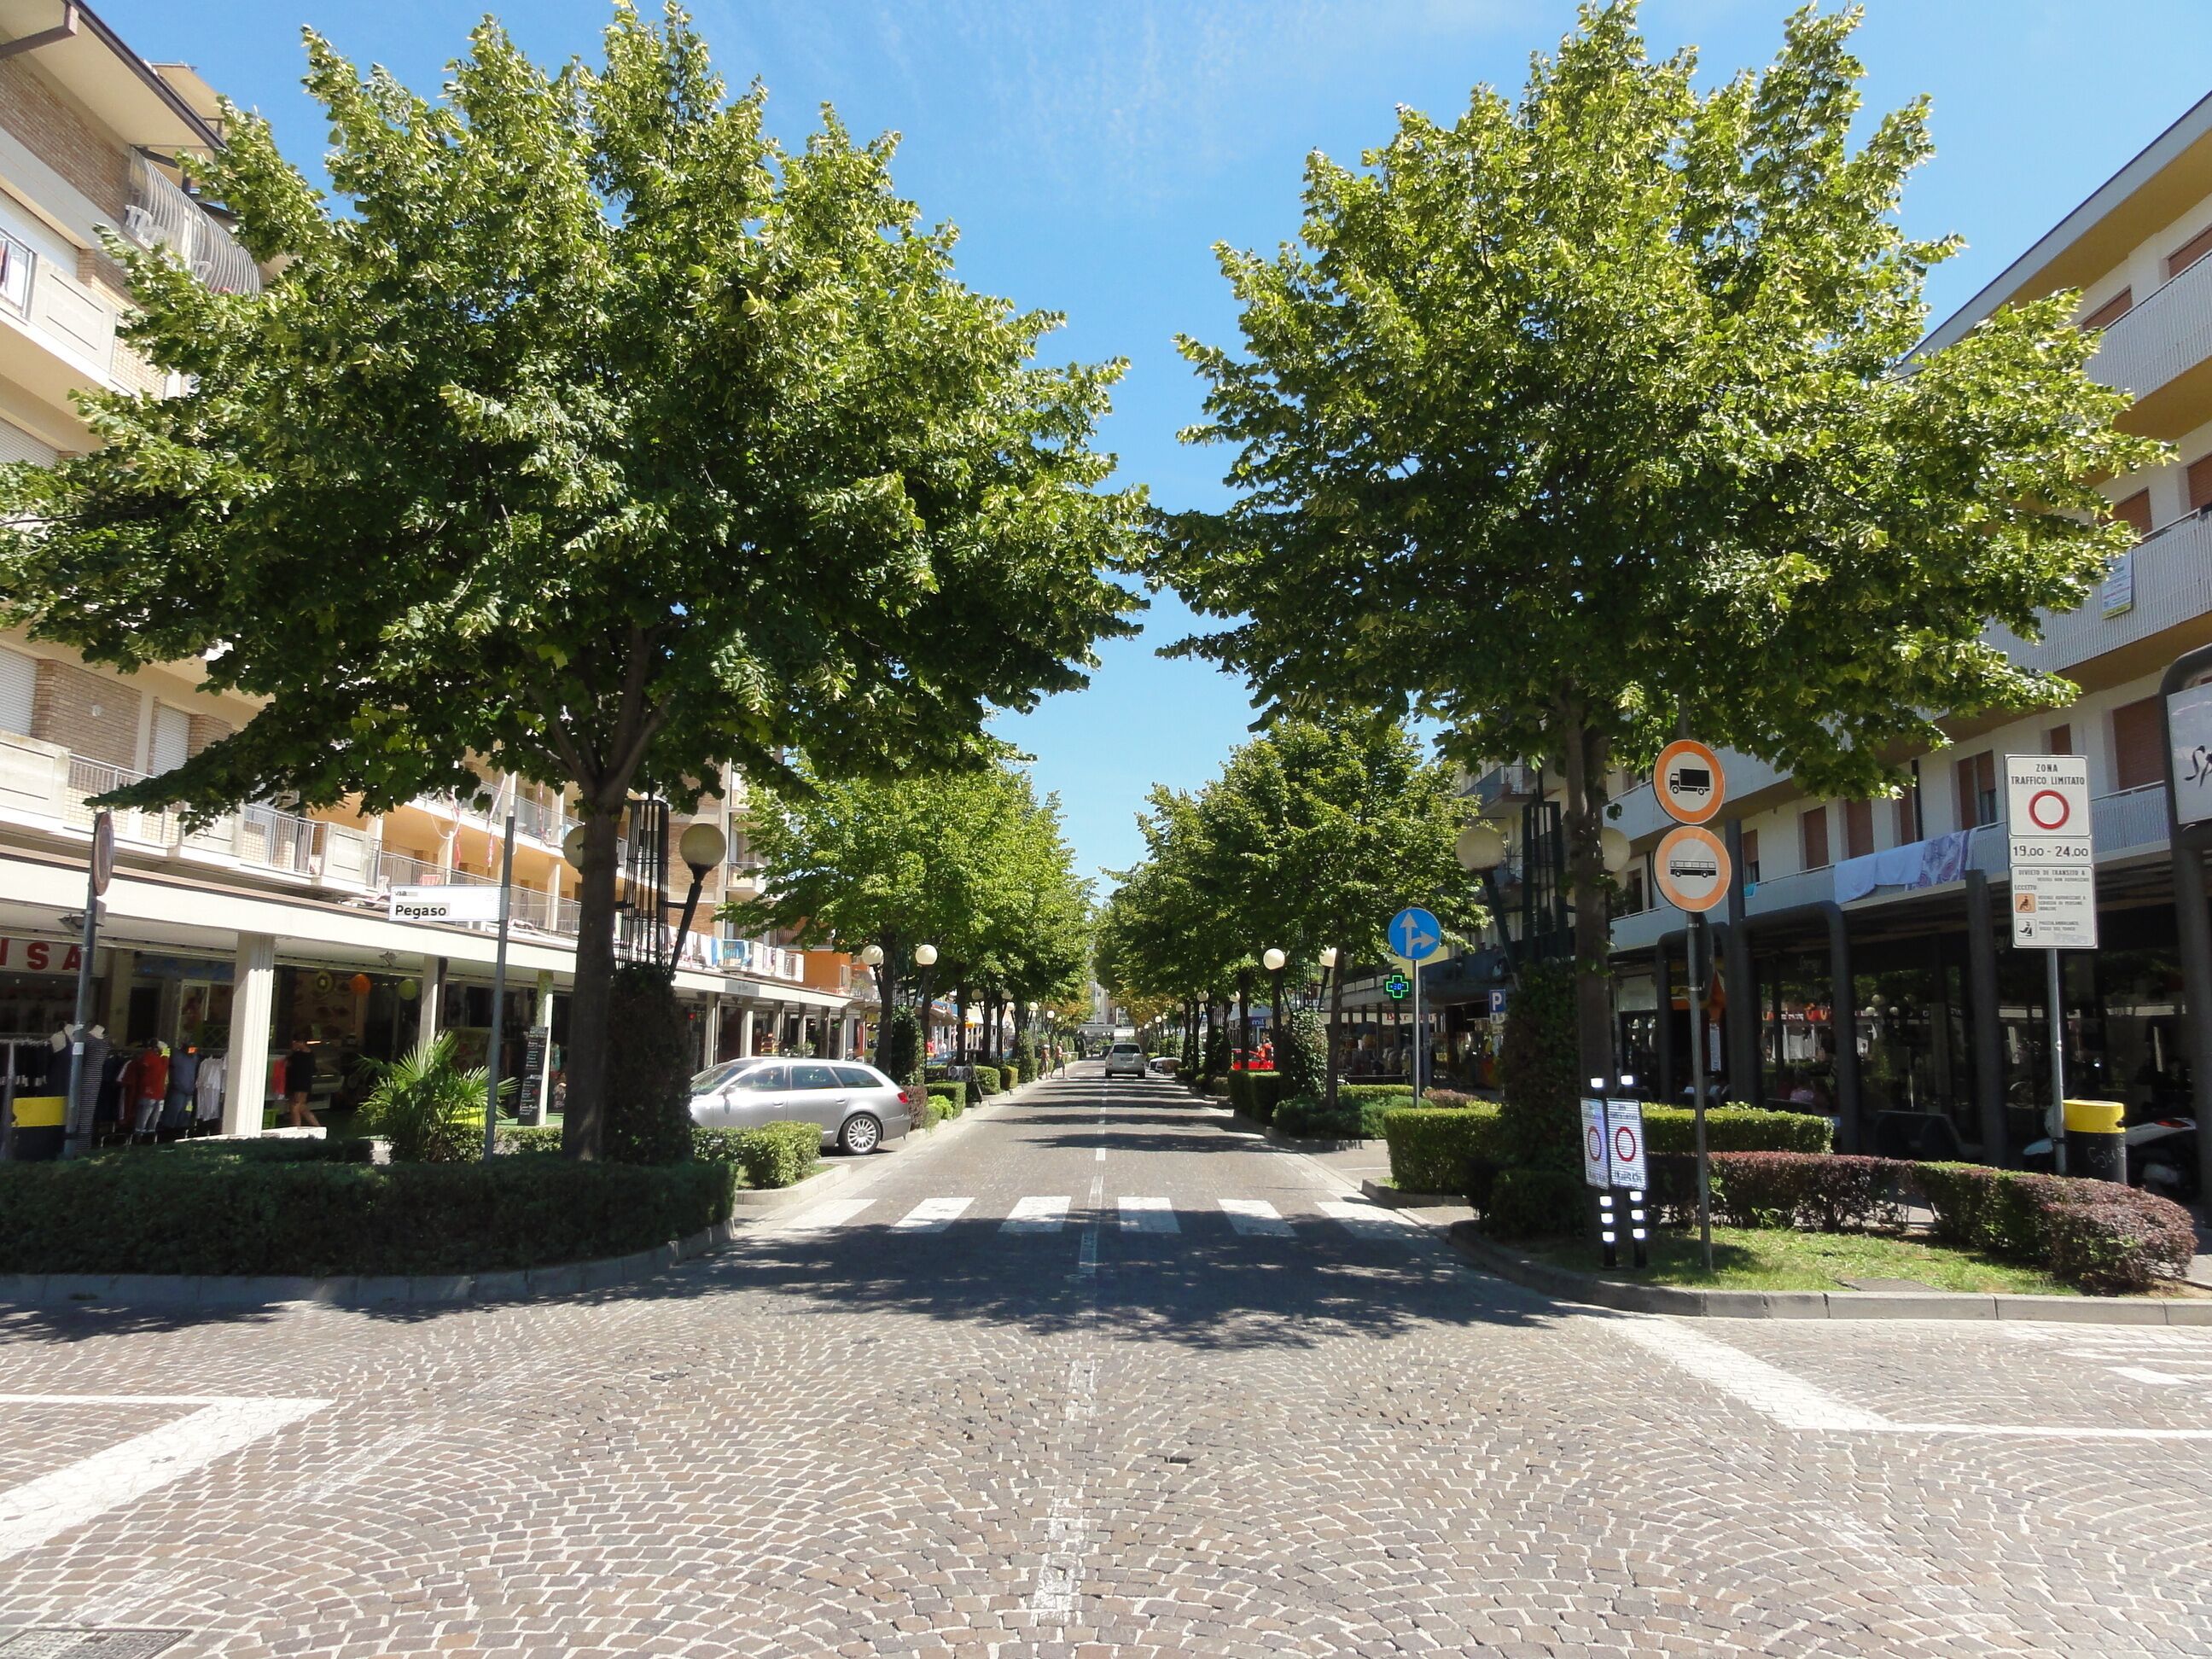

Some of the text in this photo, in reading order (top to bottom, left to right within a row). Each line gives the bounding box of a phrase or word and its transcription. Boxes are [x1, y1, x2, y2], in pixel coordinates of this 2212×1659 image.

[2035, 764, 2058, 772] ZONA
[2011, 776, 2085, 785] TRAFFICO LIMITATO
[2012, 845, 2044, 857] 19.00
[2055, 846, 2088, 857] 24.00
[395, 905, 446, 919] Pegaso
[1492, 992, 1502, 1011] P
